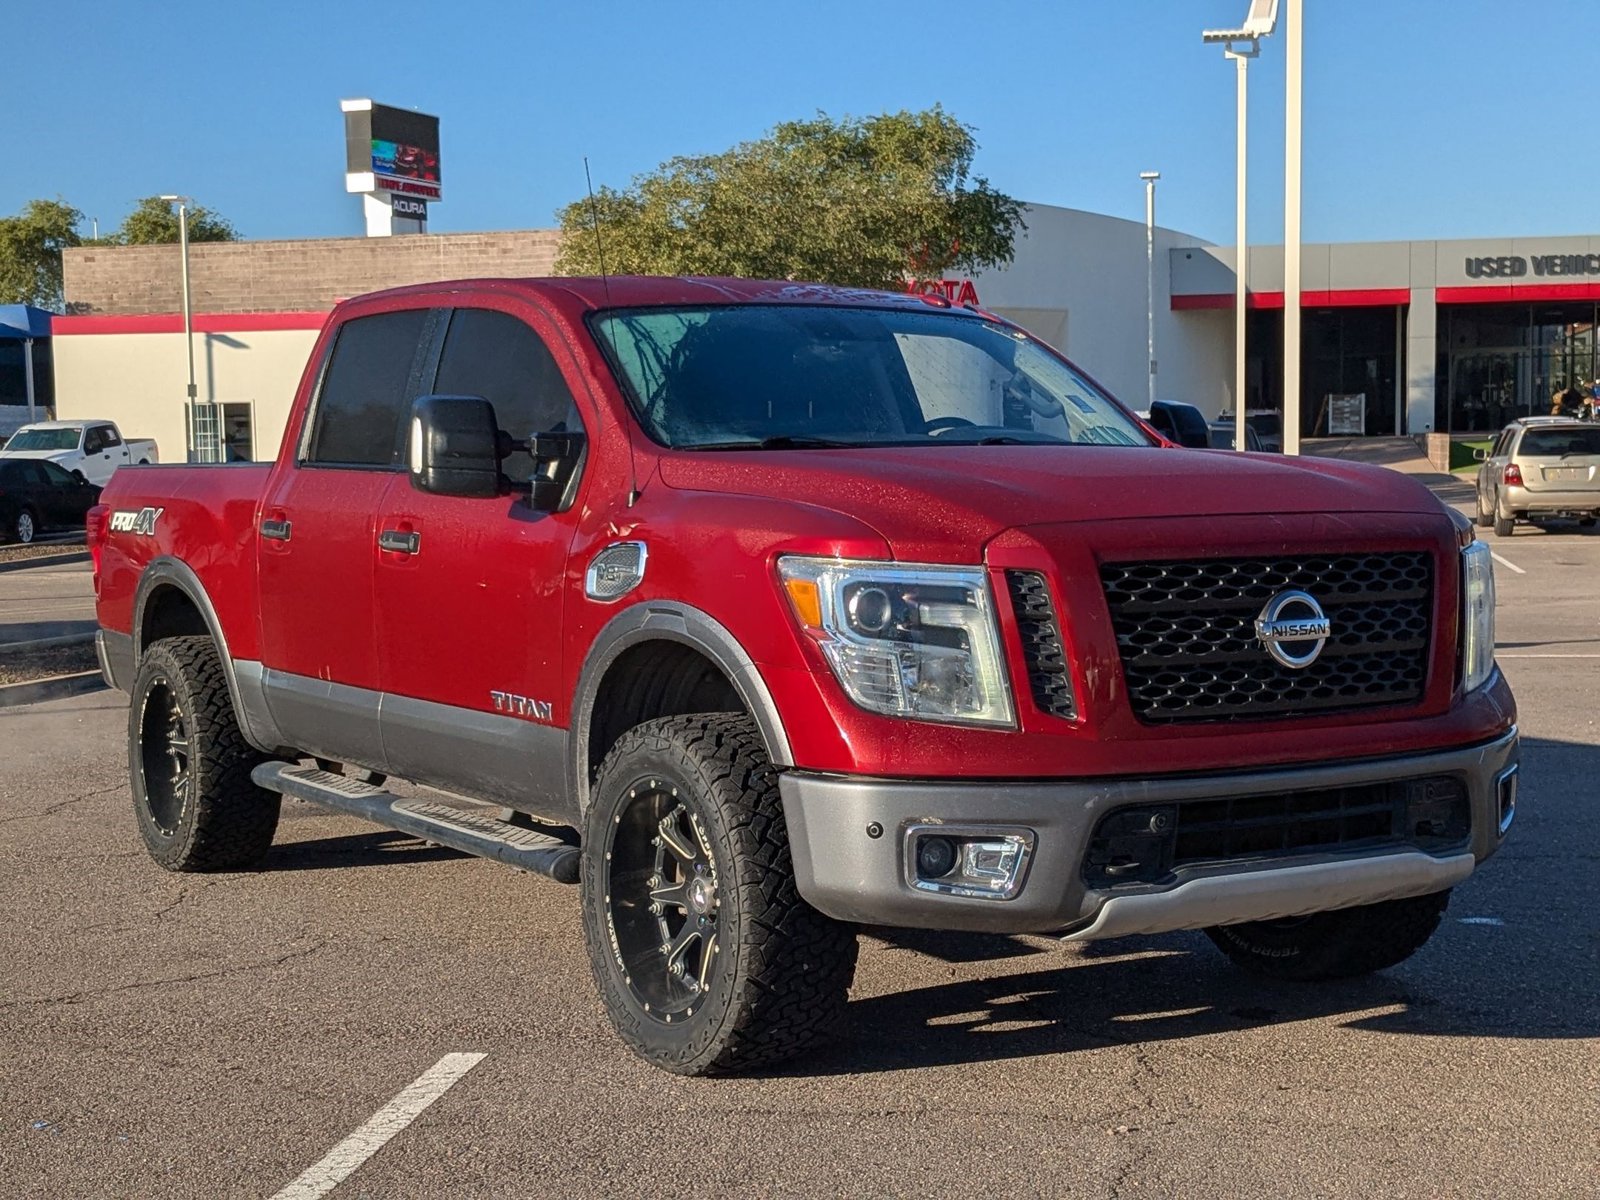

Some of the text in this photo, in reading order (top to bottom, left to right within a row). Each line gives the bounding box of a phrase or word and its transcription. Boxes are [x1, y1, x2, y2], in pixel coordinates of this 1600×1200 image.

[393, 200, 425, 215] ACURA
[1465, 256, 1527, 278] USED
[1271, 622, 1326, 637] NISSAN
[490, 690, 553, 722] TITAN
